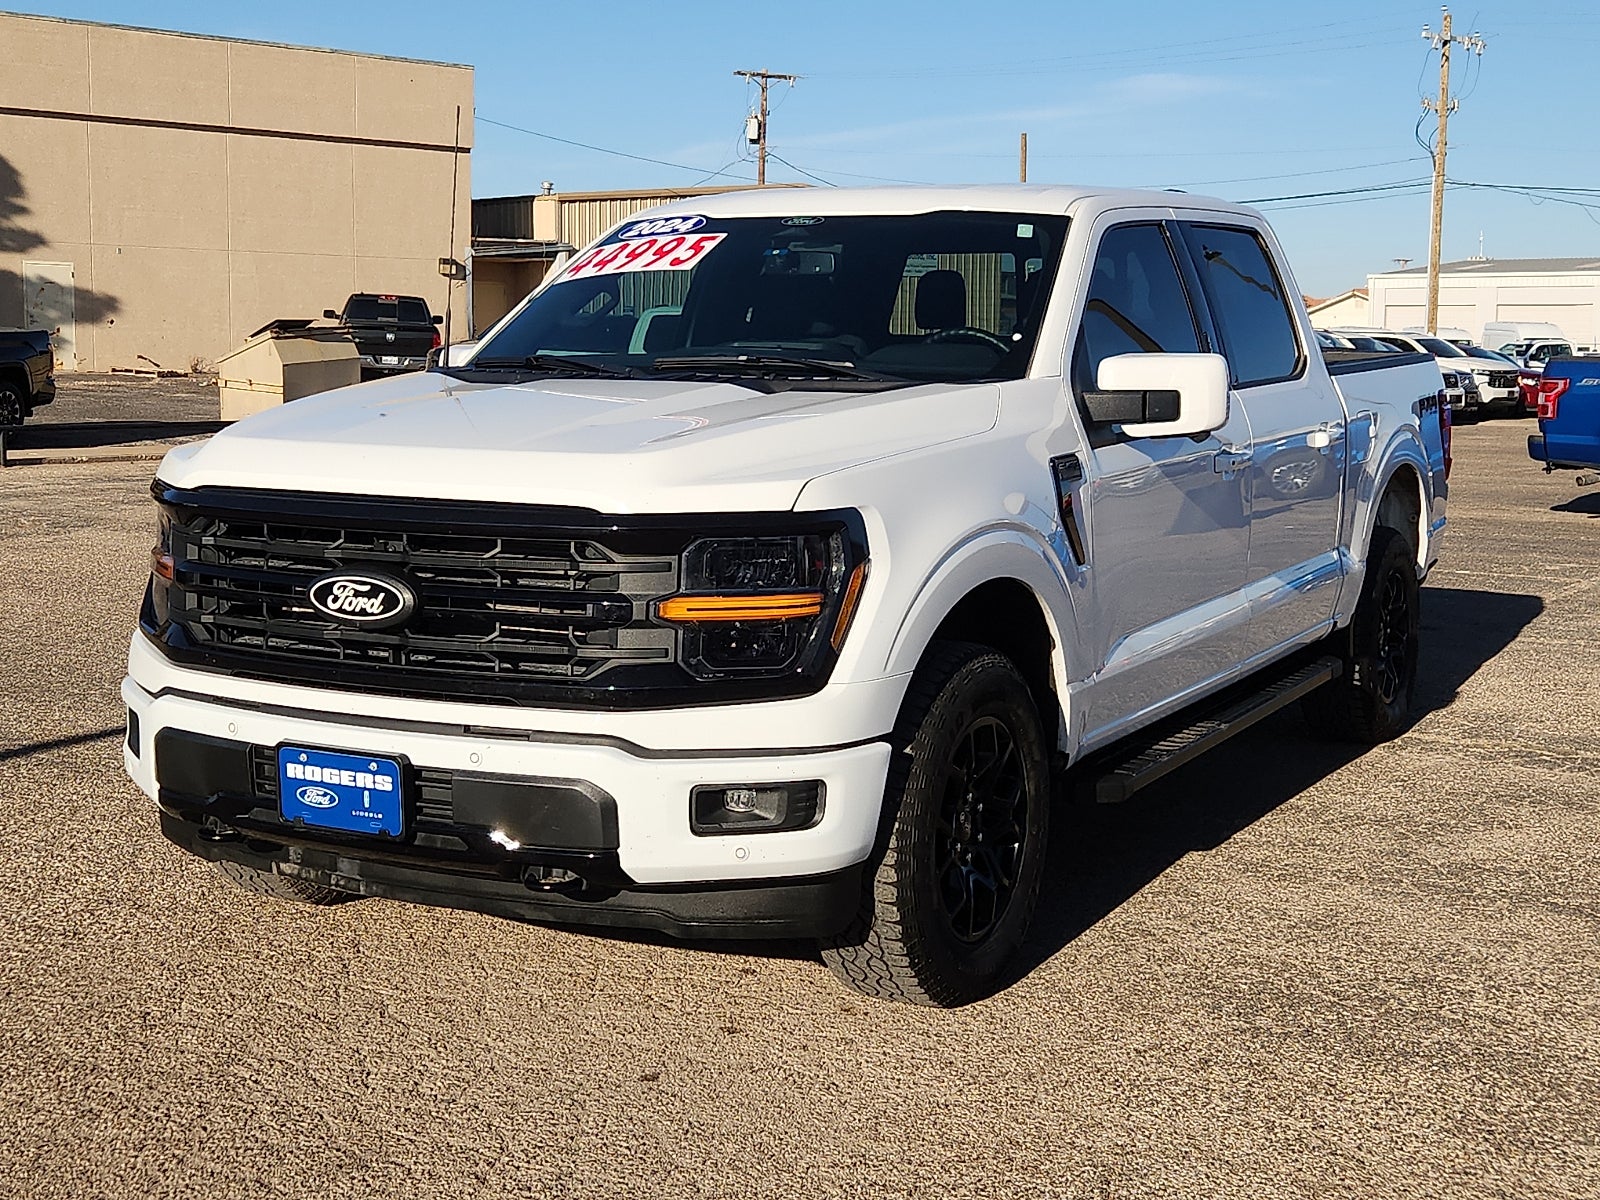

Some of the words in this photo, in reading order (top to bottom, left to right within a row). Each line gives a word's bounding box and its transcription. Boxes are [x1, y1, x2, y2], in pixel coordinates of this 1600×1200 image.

[628, 217, 696, 236] 2024
[566, 235, 721, 277] 44995
[326, 581, 386, 614] Ford
[286, 762, 393, 792] ROGERS
[303, 788, 331, 805] Ford
